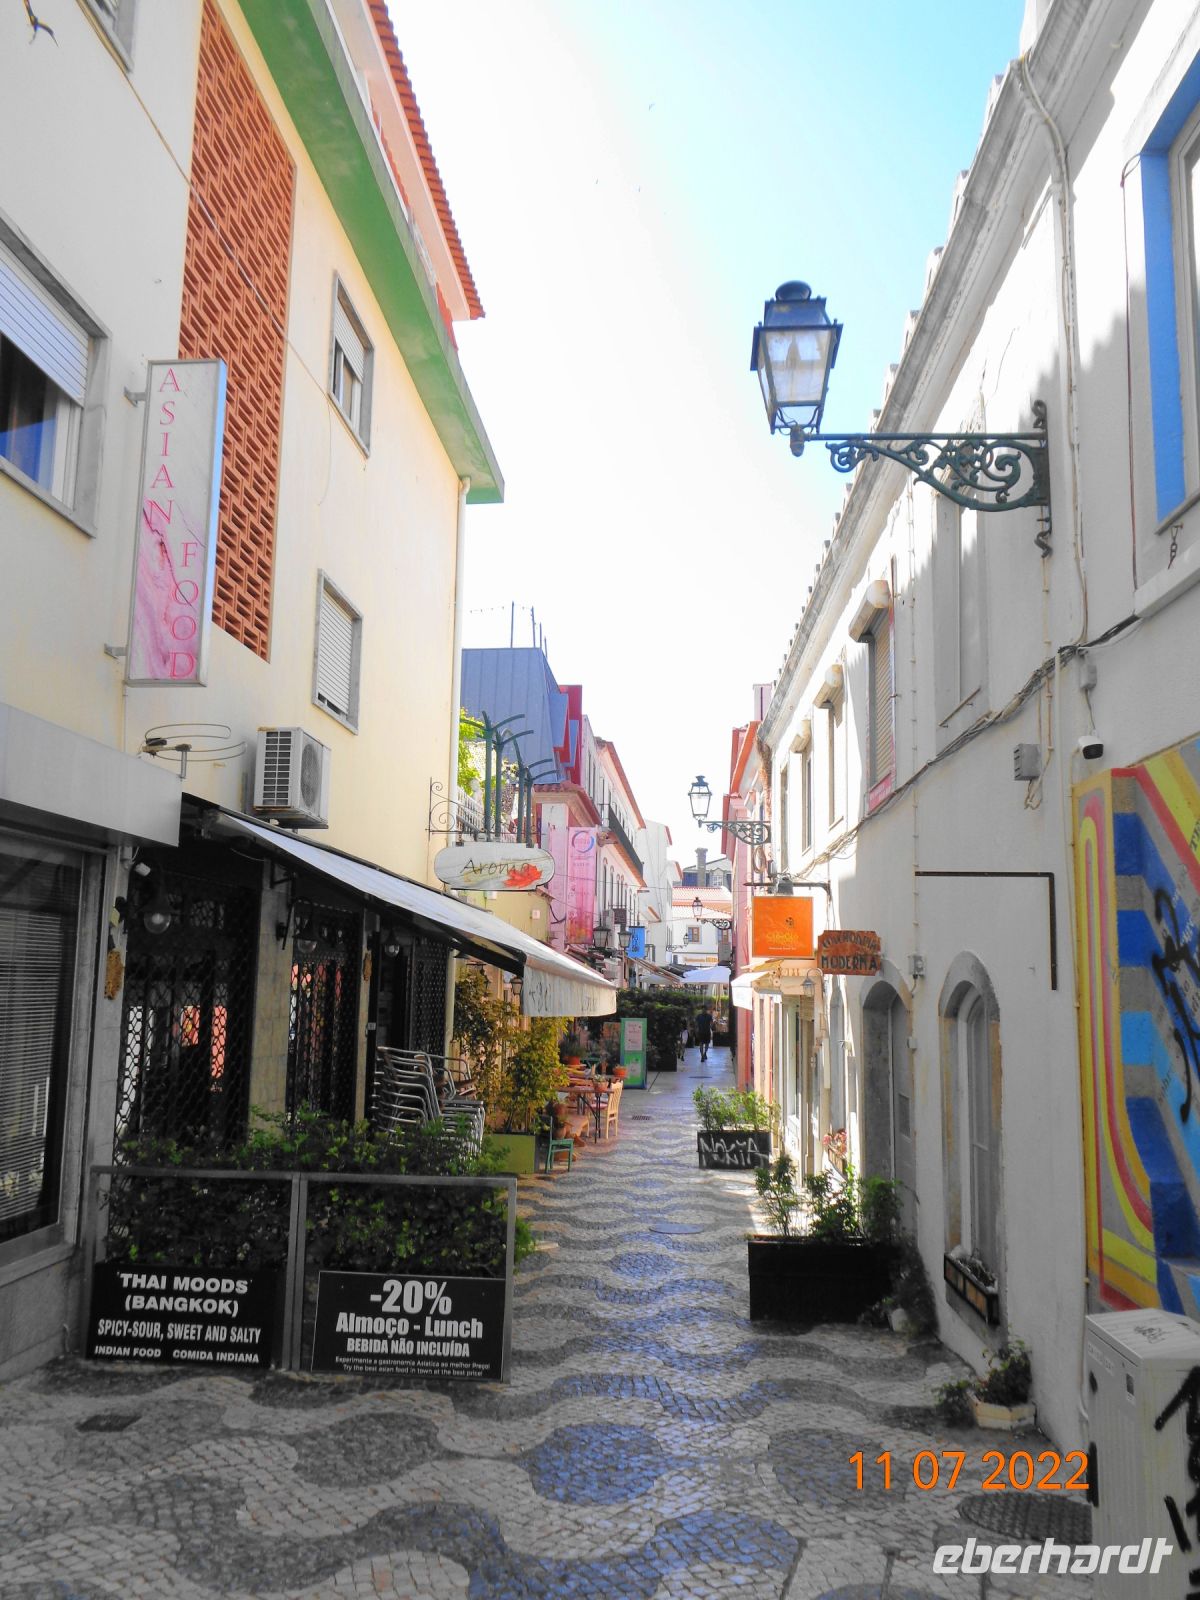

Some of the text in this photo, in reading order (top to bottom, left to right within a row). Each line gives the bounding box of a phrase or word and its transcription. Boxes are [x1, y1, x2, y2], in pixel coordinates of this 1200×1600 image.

[147, 367, 180, 525] ASIAN
[169, 541, 199, 679] FOOD
[821, 955, 878, 971] MODERNA
[120, 1273, 248, 1295] THAI MOODS
[125, 1294, 239, 1317] (BANGKOK)
[370, 1279, 453, 1316] -20%
[97, 1318, 261, 1344] SPICY-SOUR, SWEET AND SALTY
[335, 1312, 410, 1339] Almoço
[424, 1315, 484, 1339] Lunch
[94, 1345, 260, 1363] INDIAN FOOD COMIDA INDIANA
[346, 1337, 470, 1358] BEBIDA NÃO INCLUÍDA
[343, 1363, 352, 1372] Try
[417, 1367, 433, 1375] town
[441, 1368, 451, 1376] the
[449, 1360, 471, 1368] melhor
